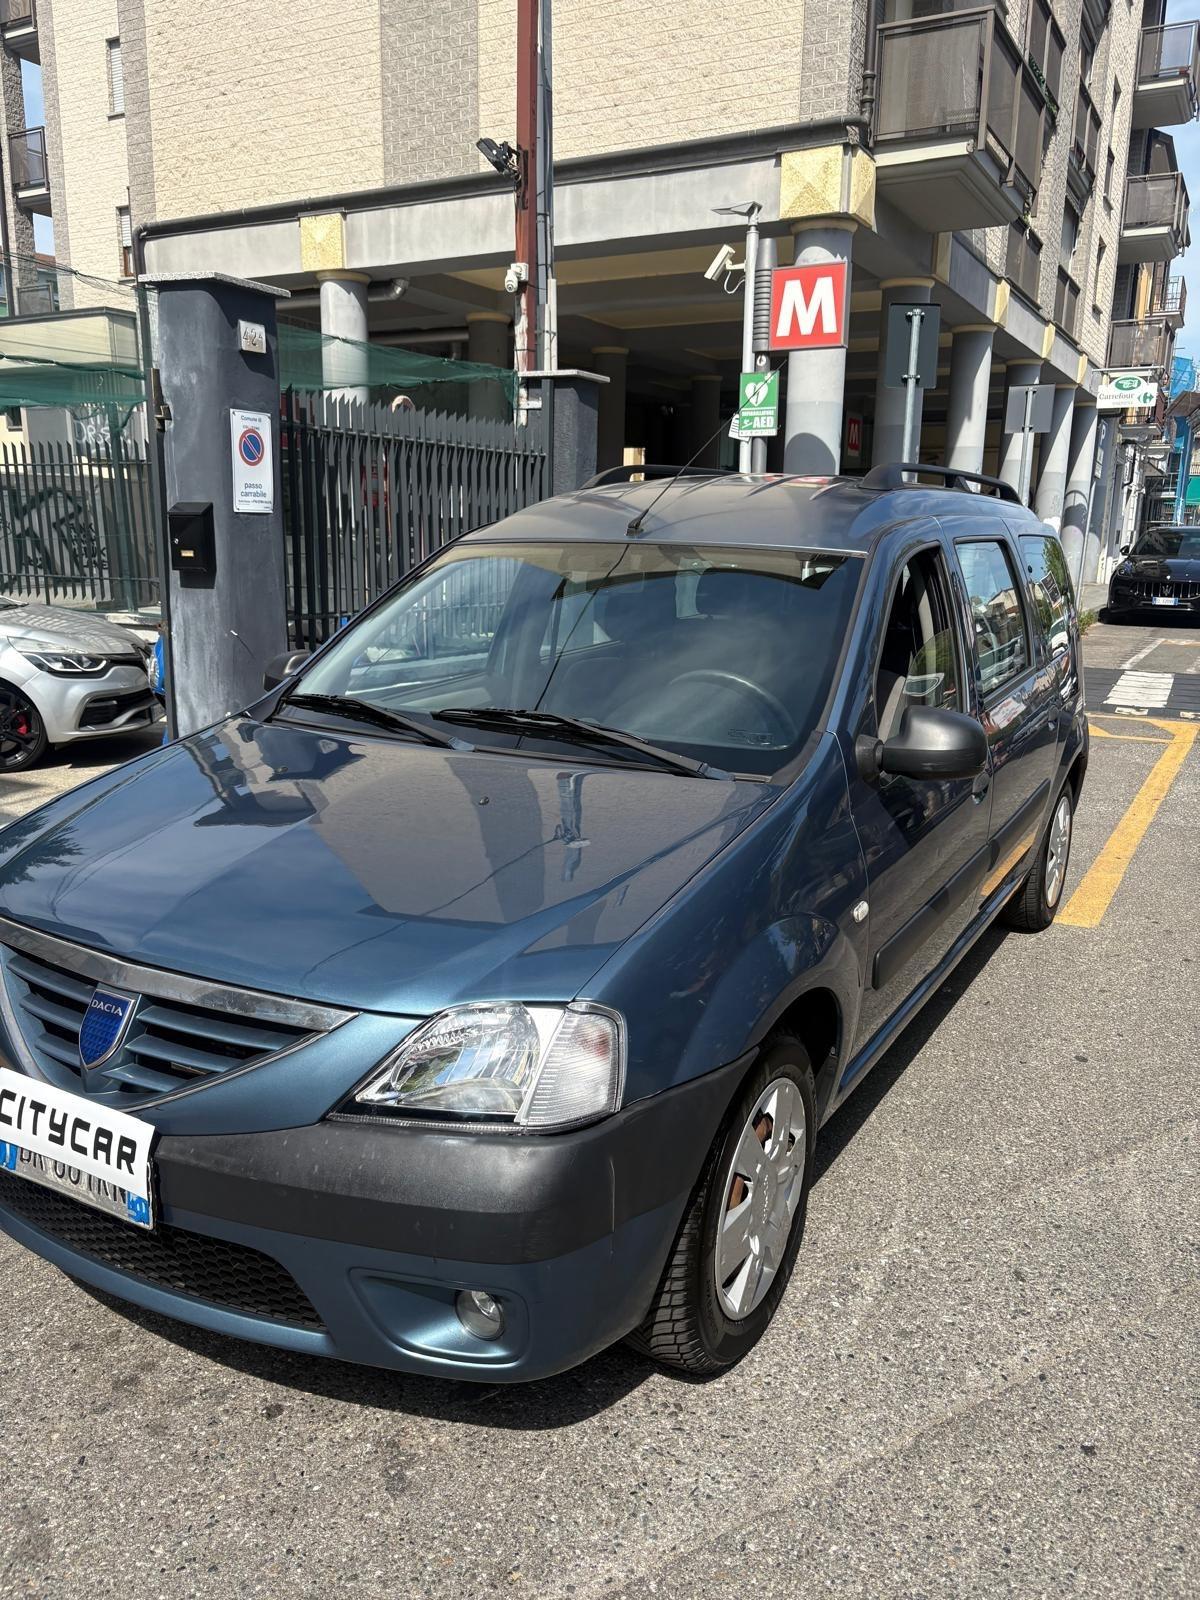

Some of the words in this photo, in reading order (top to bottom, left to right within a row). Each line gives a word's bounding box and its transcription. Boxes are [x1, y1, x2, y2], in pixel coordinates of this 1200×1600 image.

[776, 277, 838, 337] M
[753, 417, 774, 428] AED
[241, 490, 267, 498] carrabile
[91, 1000, 122, 1016] DACIA
[0, 1089, 137, 1175] CITYCAR
